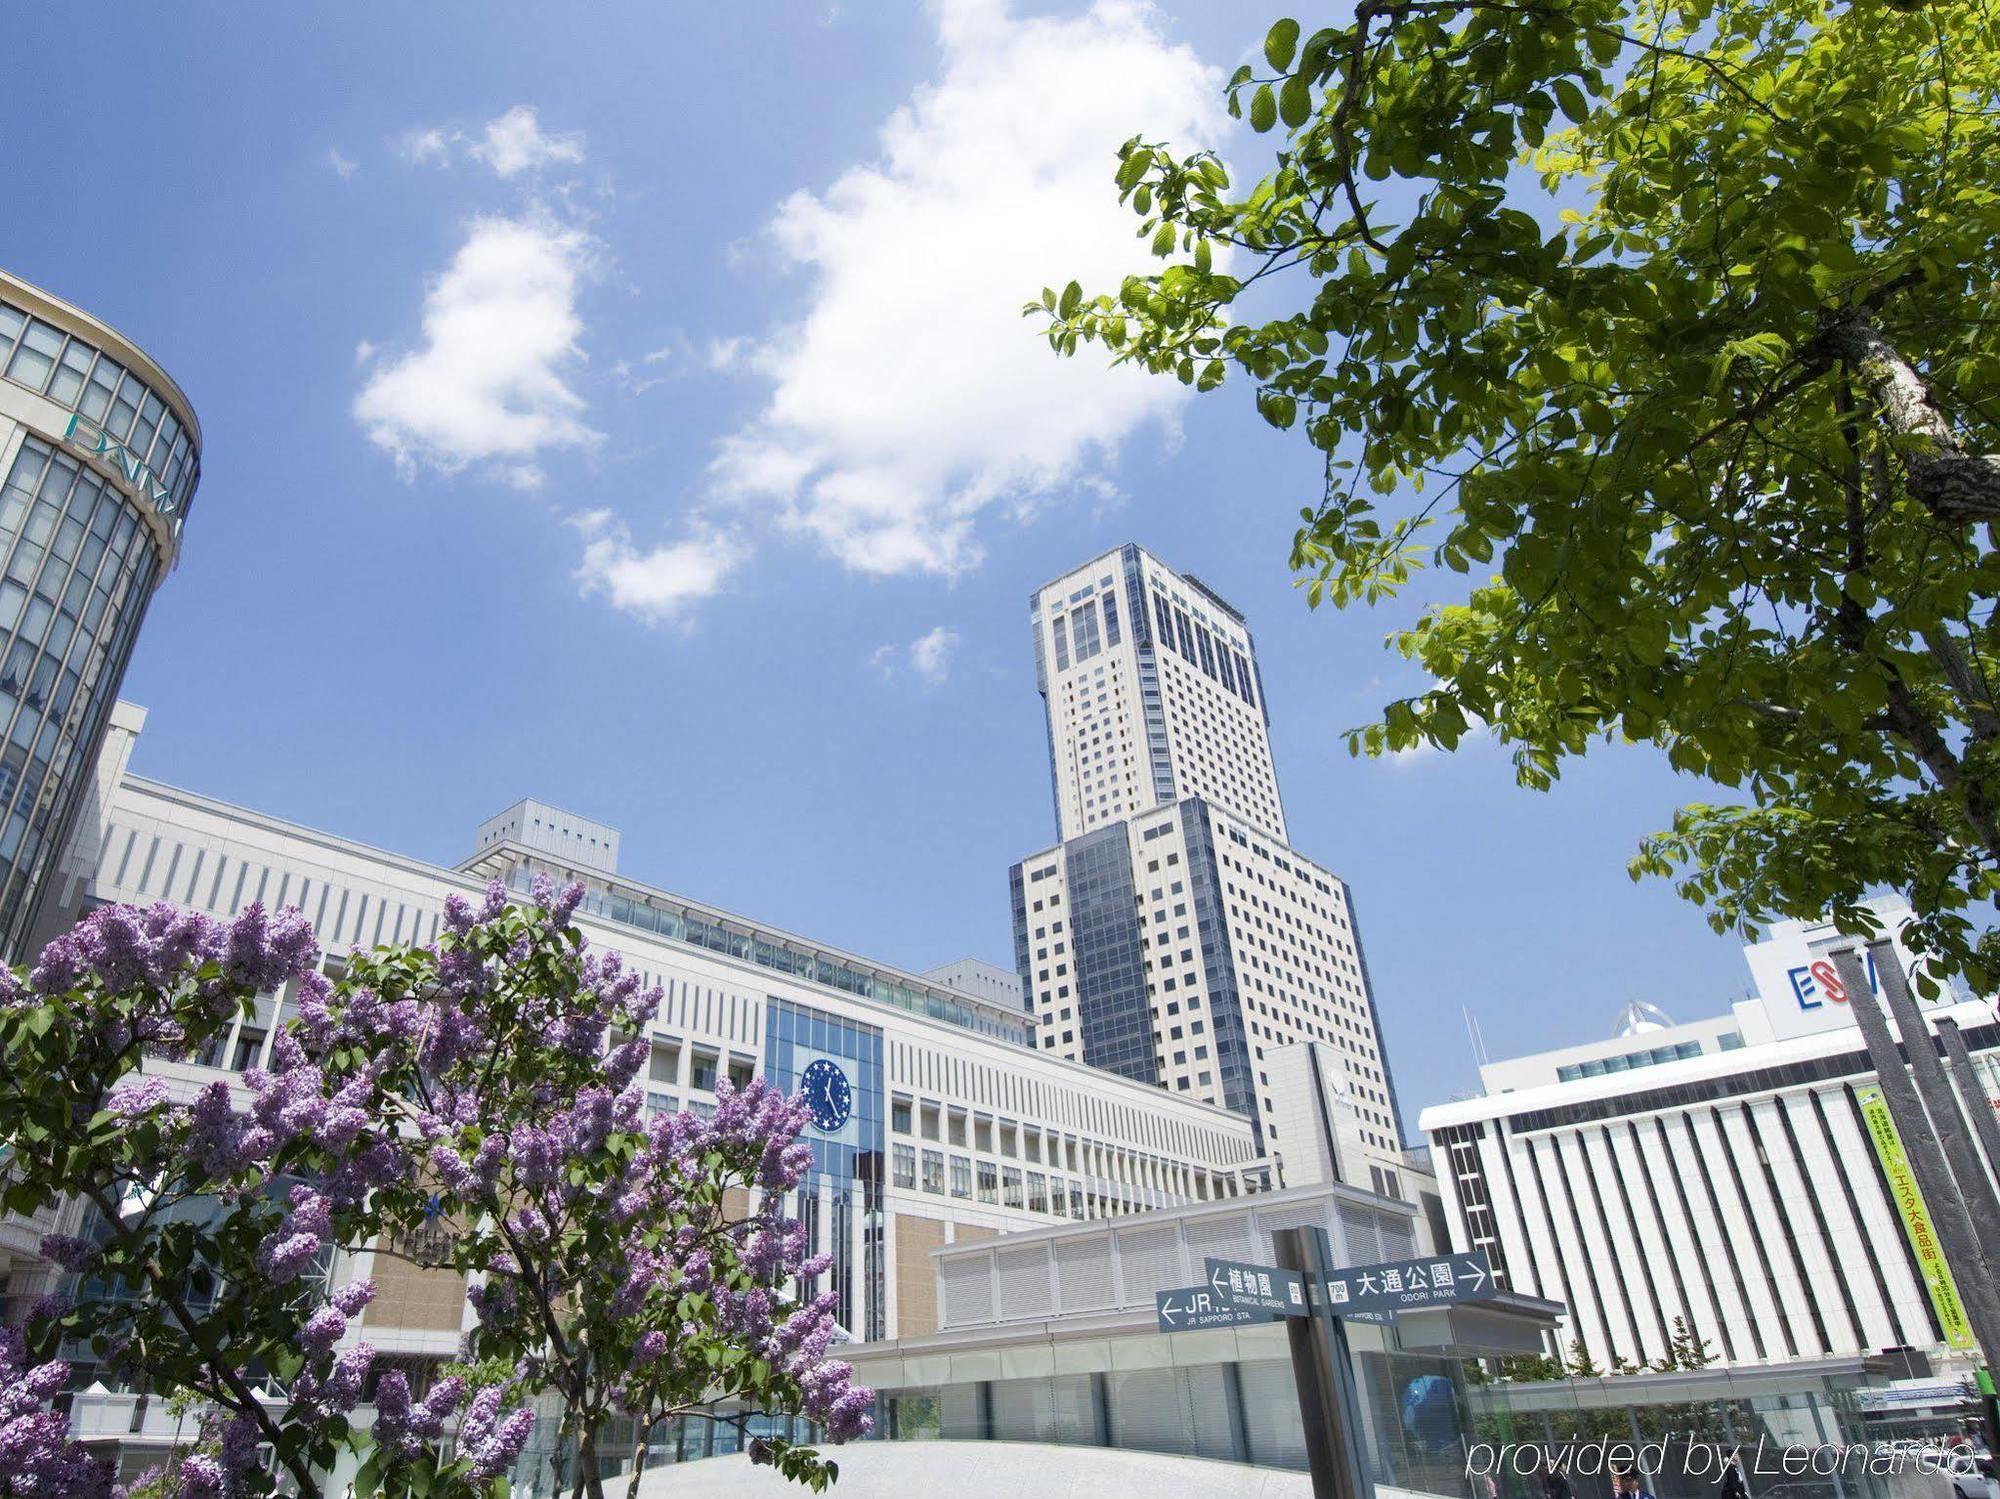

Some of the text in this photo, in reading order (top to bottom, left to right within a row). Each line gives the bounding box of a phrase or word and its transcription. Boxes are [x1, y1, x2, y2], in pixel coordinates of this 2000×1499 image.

[1895, 1175, 1936, 1260] エスタ大食品街
[1228, 1267, 1272, 1297] 植物園
[1356, 1262, 1454, 1296] 大通公園
[1400, 1288, 1456, 1302] ODORI PARK
[1187, 1317, 1197, 1325] JR
[1199, 1313, 1234, 1325] SAPPORO
